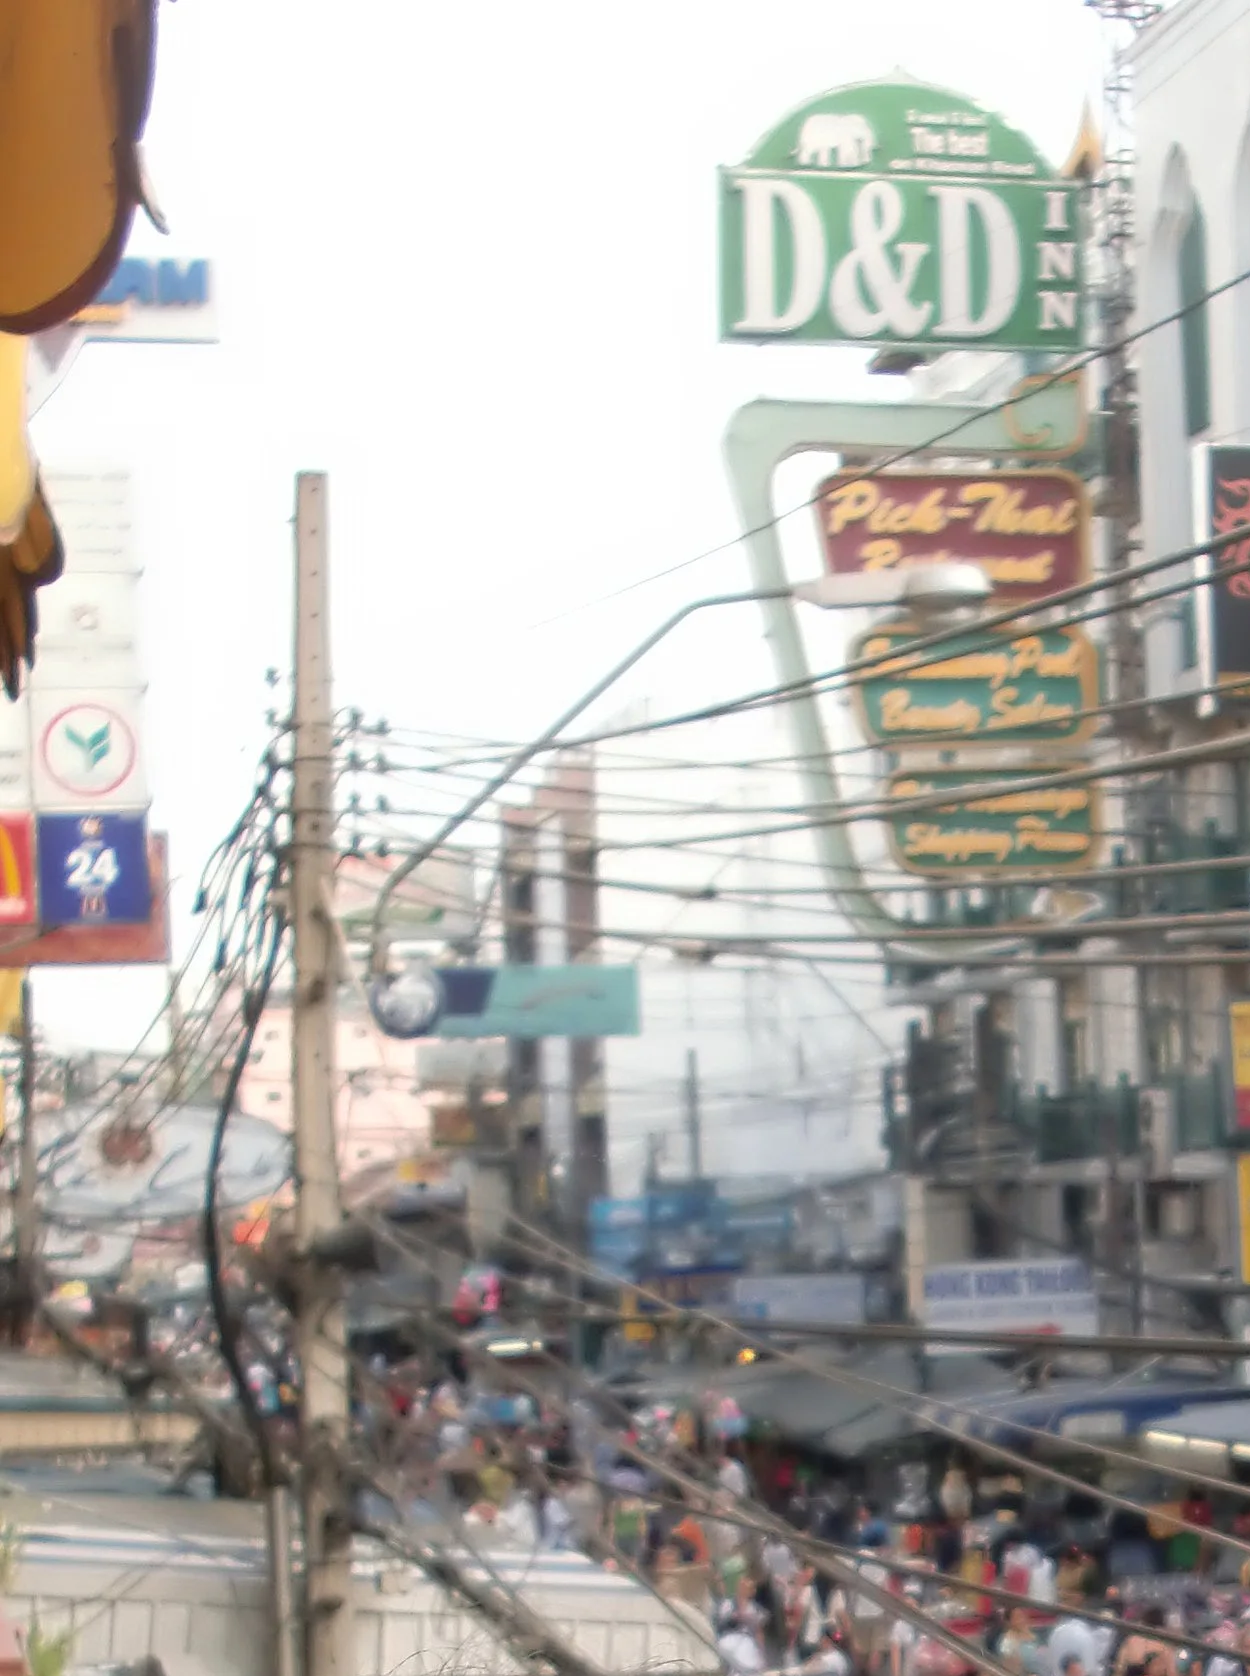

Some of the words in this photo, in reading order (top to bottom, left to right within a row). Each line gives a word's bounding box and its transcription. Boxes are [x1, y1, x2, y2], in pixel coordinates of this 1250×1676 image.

[733, 179, 1022, 339] D&D
[1037, 191, 1079, 331] INN
[64, 846, 121, 889] 24
